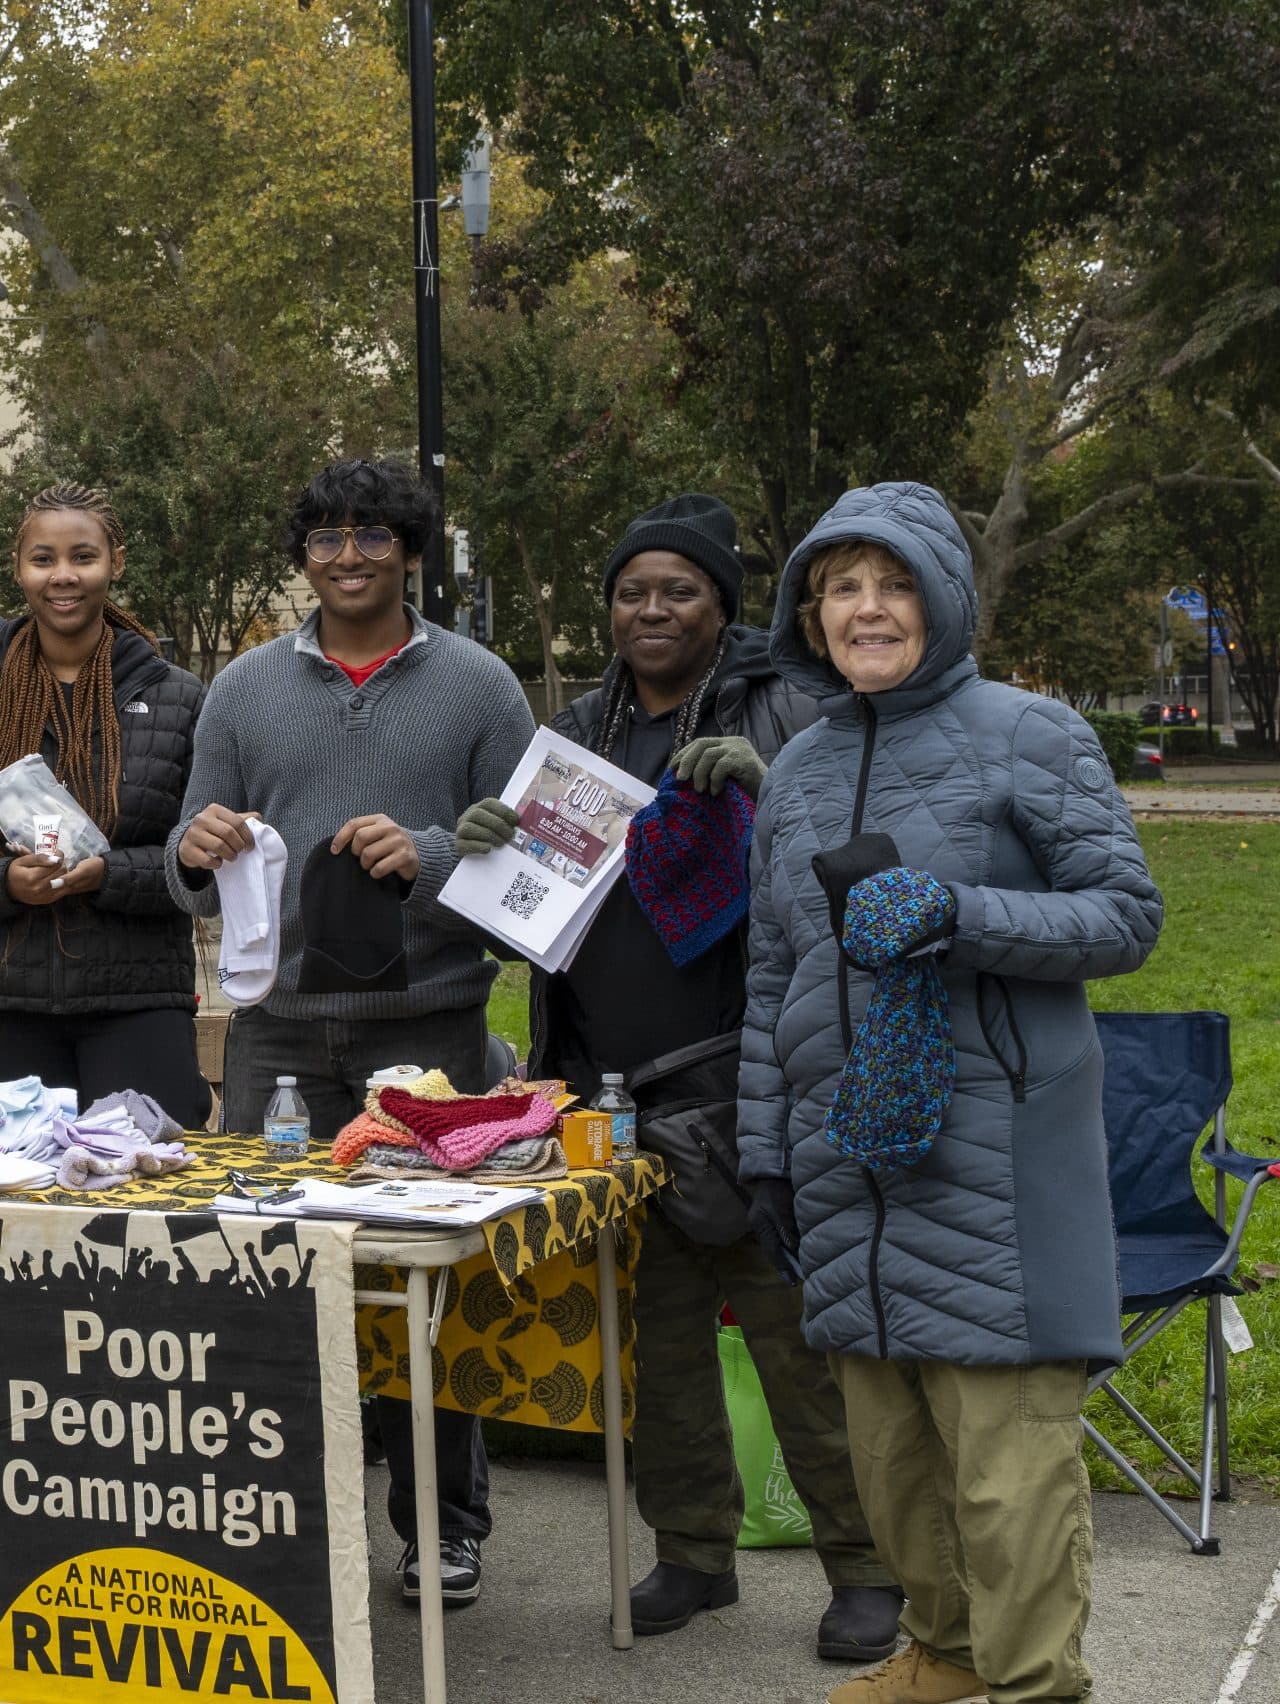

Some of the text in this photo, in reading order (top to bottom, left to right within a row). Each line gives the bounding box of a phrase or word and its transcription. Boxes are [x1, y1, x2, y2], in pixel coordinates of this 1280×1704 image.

[564, 774, 607, 817] FOOD
[594, 1120, 602, 1161] STORAGE
[63, 1310, 216, 1382] Poor
[9, 1379, 284, 1465] People's
[2, 1459, 297, 1546] Campaign
[35, 1584, 268, 1627] CALL FOR MORAL
[66, 1563, 224, 1600] A NATIONAL
[11, 1611, 312, 1700] REVIVAL
